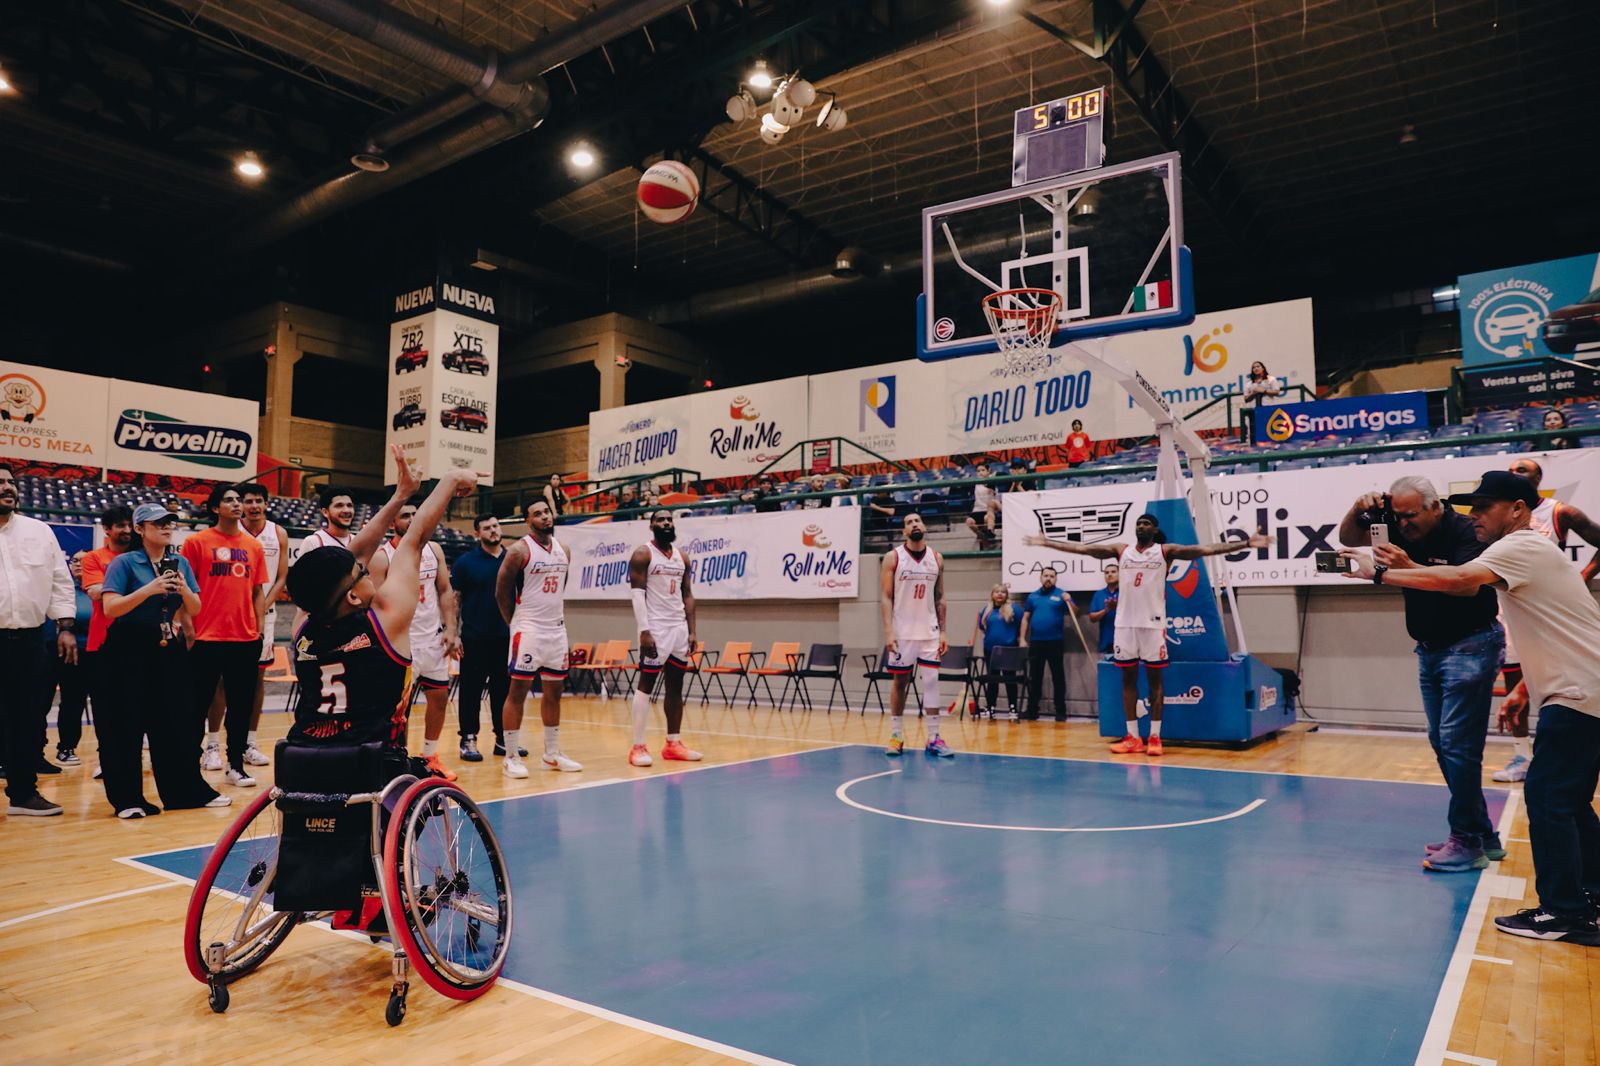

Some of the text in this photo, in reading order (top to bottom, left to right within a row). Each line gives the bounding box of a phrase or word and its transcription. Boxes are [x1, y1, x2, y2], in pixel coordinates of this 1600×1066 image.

[395, 286, 434, 313] NUEVA
[443, 283, 495, 315] NUEVA
[1467, 277, 1554, 309] 100% ELÉCTRICA
[453, 331, 484, 352] XT5
[1482, 369, 1575, 388] Venta exclsiva
[1528, 382, 1553, 393] sol
[441, 392, 489, 413] ESCALADE
[964, 384, 1026, 432] DARLO
[1034, 369, 1092, 417] TODO
[12, 424, 58, 438] EXPRESS
[1295, 408, 1416, 433] Smartgas
[47, 438, 93, 455] MEZA
[117, 421, 250, 458] Provelim
[710, 426, 743, 459] Roll
[989, 430, 1063, 446] ANÚNCIATE AQUÍ
[598, 428, 678, 473] HACER EQUIPO
[1186, 487, 1269, 511] rupo
[1193, 507, 1338, 562] élix
[686, 537, 725, 555] PIONERO
[699, 550, 748, 587] EQUIPO
[782, 550, 852, 582] Roll n'Me
[1213, 565, 1320, 581] utomotriz
[542, 576, 559, 593] 55
[580, 565, 594, 590] MI
[1134, 572, 1143, 587] 6
[913, 584, 926, 600] 10
[1165, 615, 1205, 629] COPA
[317, 662, 349, 714] 5
[305, 818, 336, 828] LINCE
